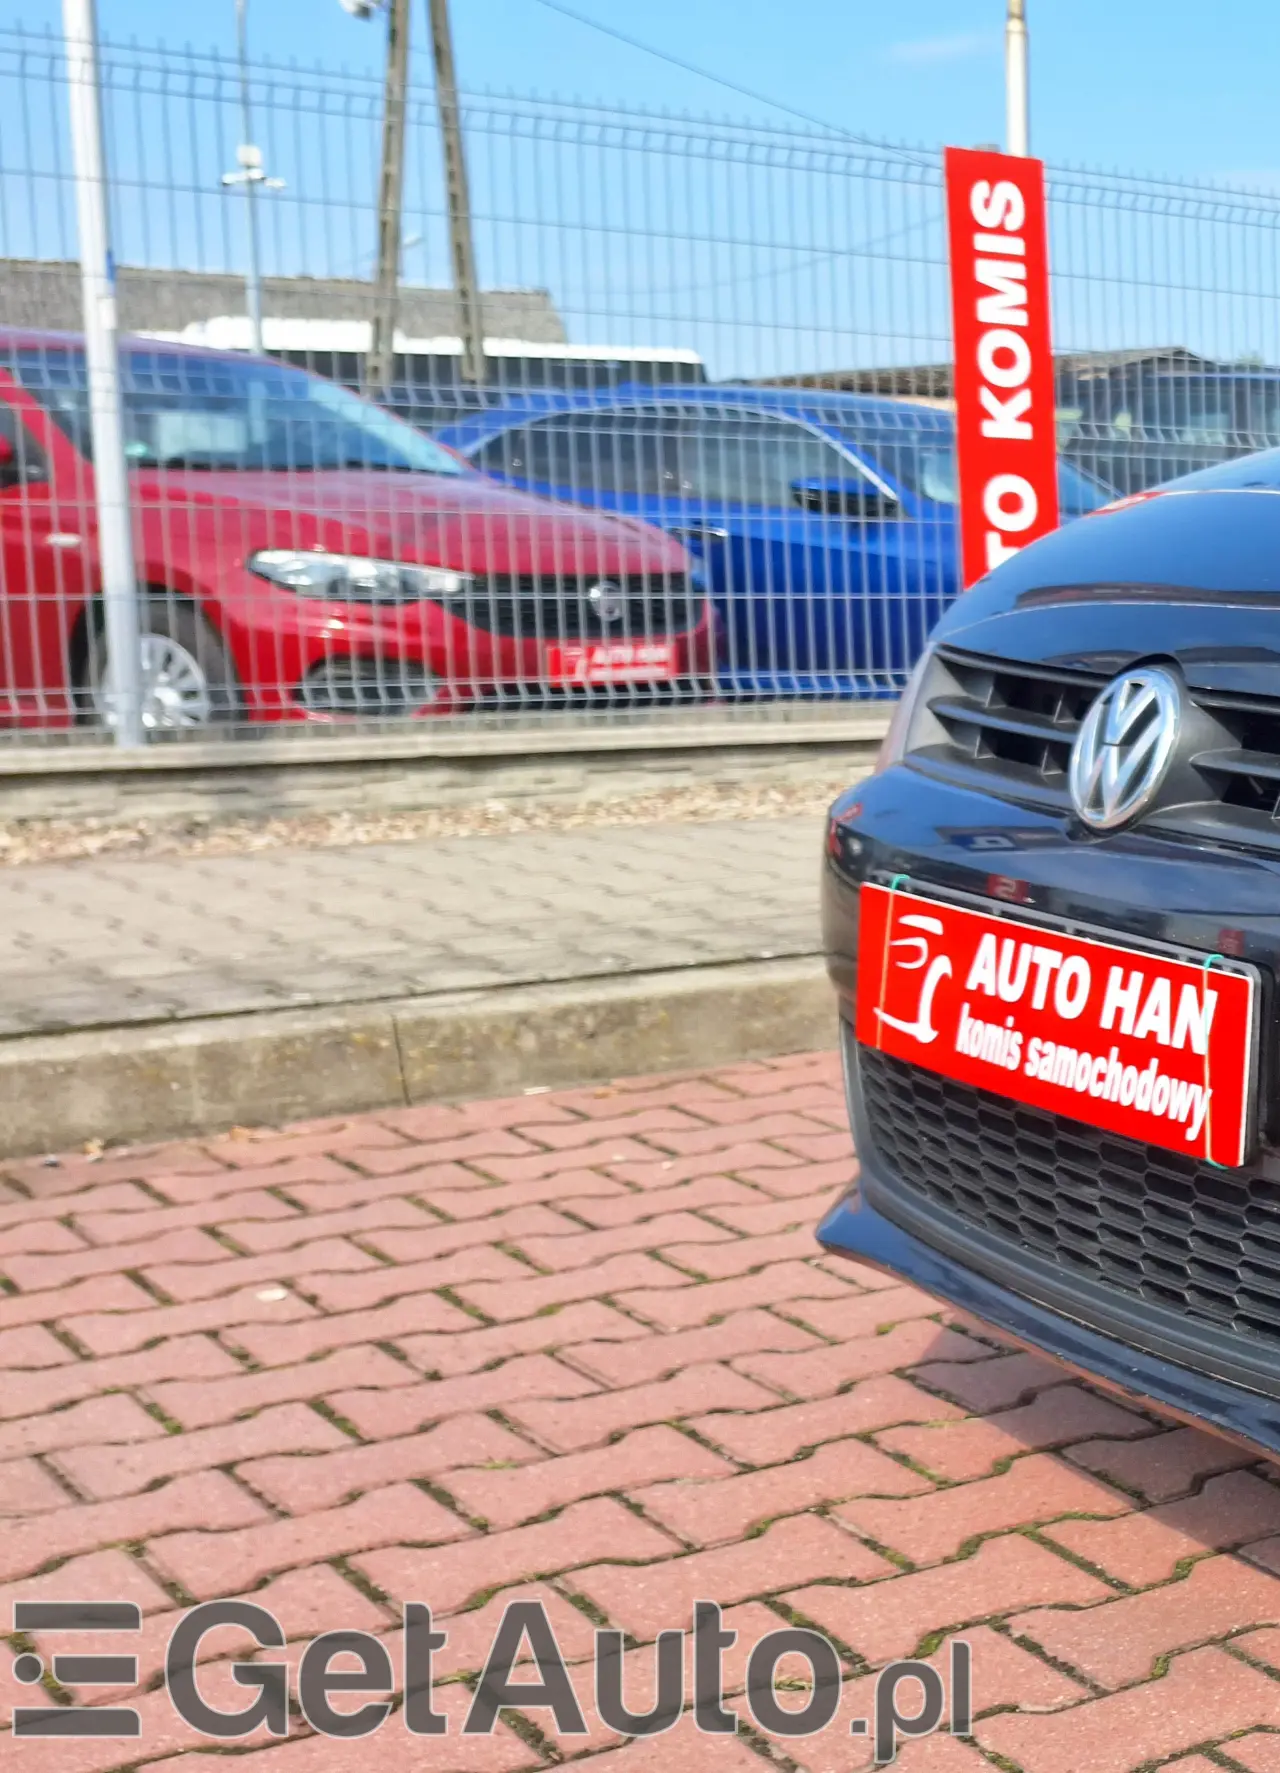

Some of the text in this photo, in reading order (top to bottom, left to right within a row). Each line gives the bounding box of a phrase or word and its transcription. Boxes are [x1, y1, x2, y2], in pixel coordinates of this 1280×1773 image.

[970, 179, 1033, 440] KOMIS
[965, 932, 1219, 1056] AUTO HAN
[955, 1001, 1213, 1142] komis samochodowy
